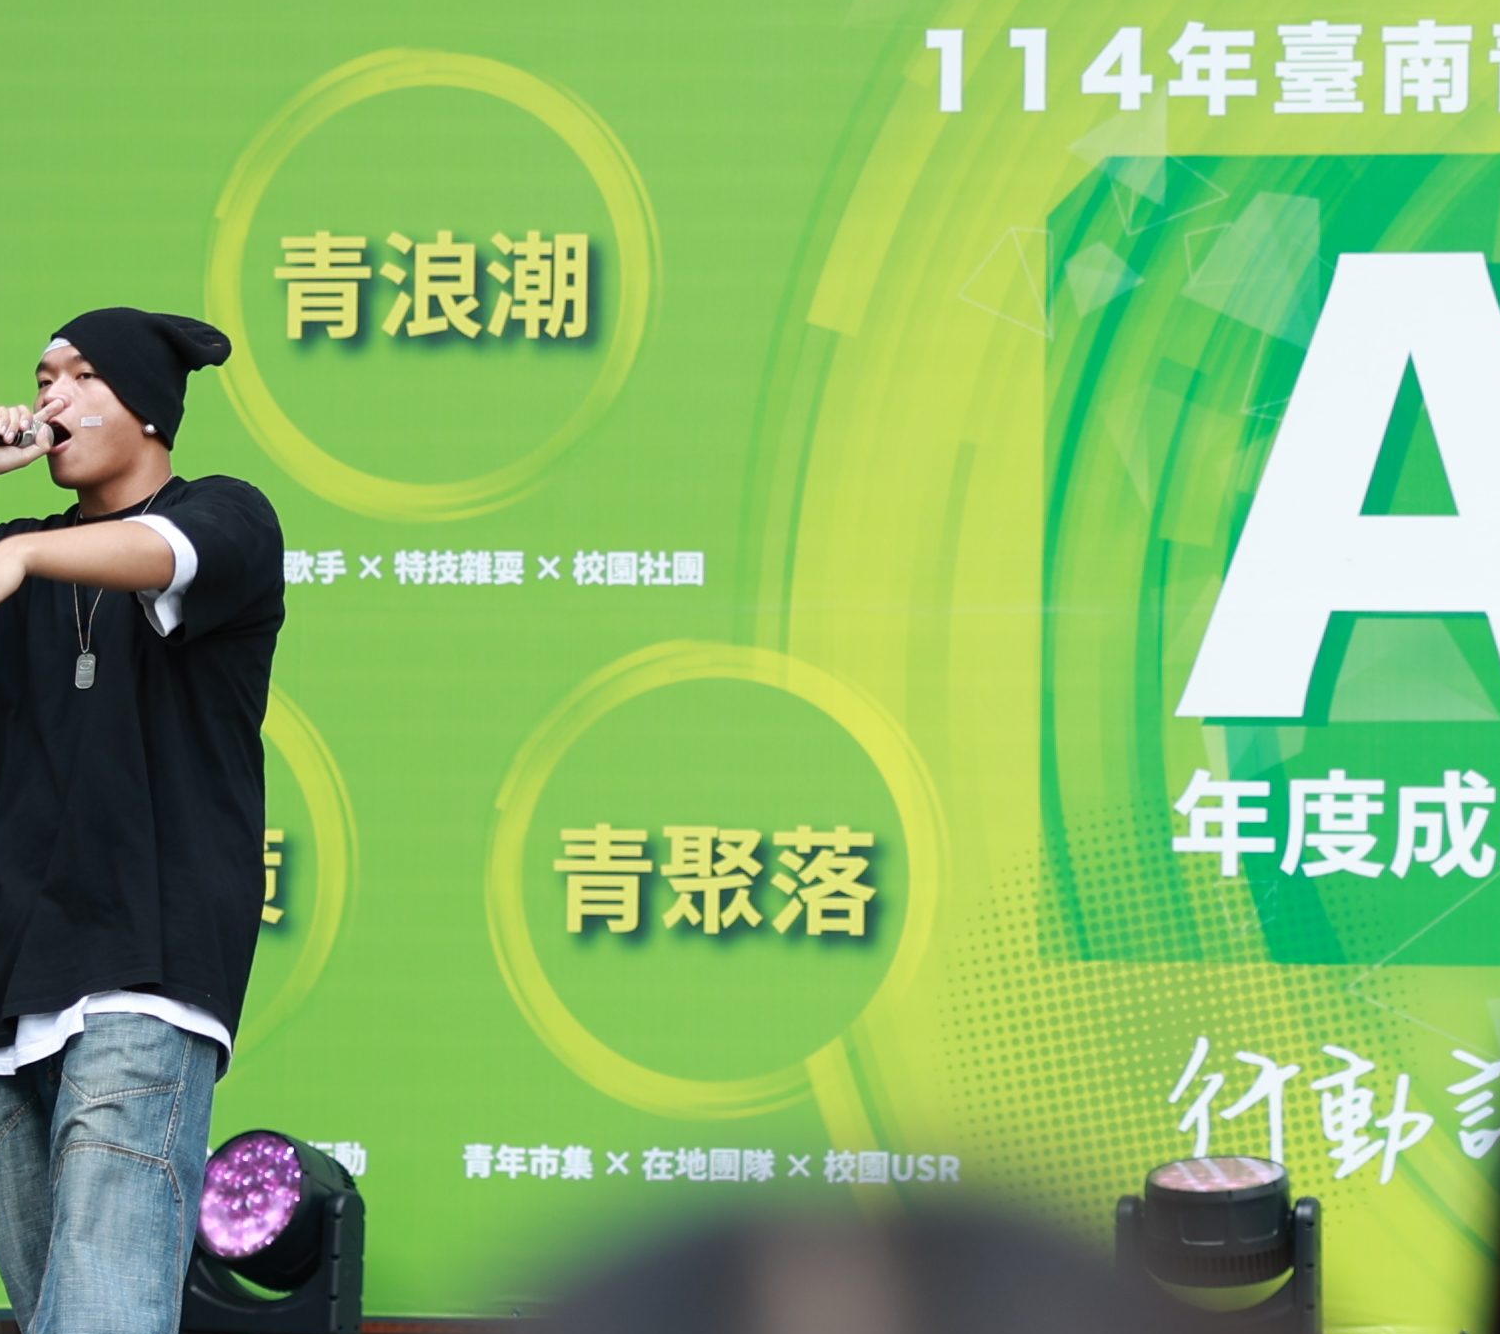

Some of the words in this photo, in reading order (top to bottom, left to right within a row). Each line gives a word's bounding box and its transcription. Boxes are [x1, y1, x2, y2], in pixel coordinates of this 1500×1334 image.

[273, 230, 590, 342] 青浪潮
[394, 550, 525, 586] 特技雜耍
[572, 550, 705, 587] 校園社團
[552, 823, 876, 938] 青聚落
[462, 1143, 593, 1180] 青年市集
[641, 1146, 776, 1183] 在地團隊
